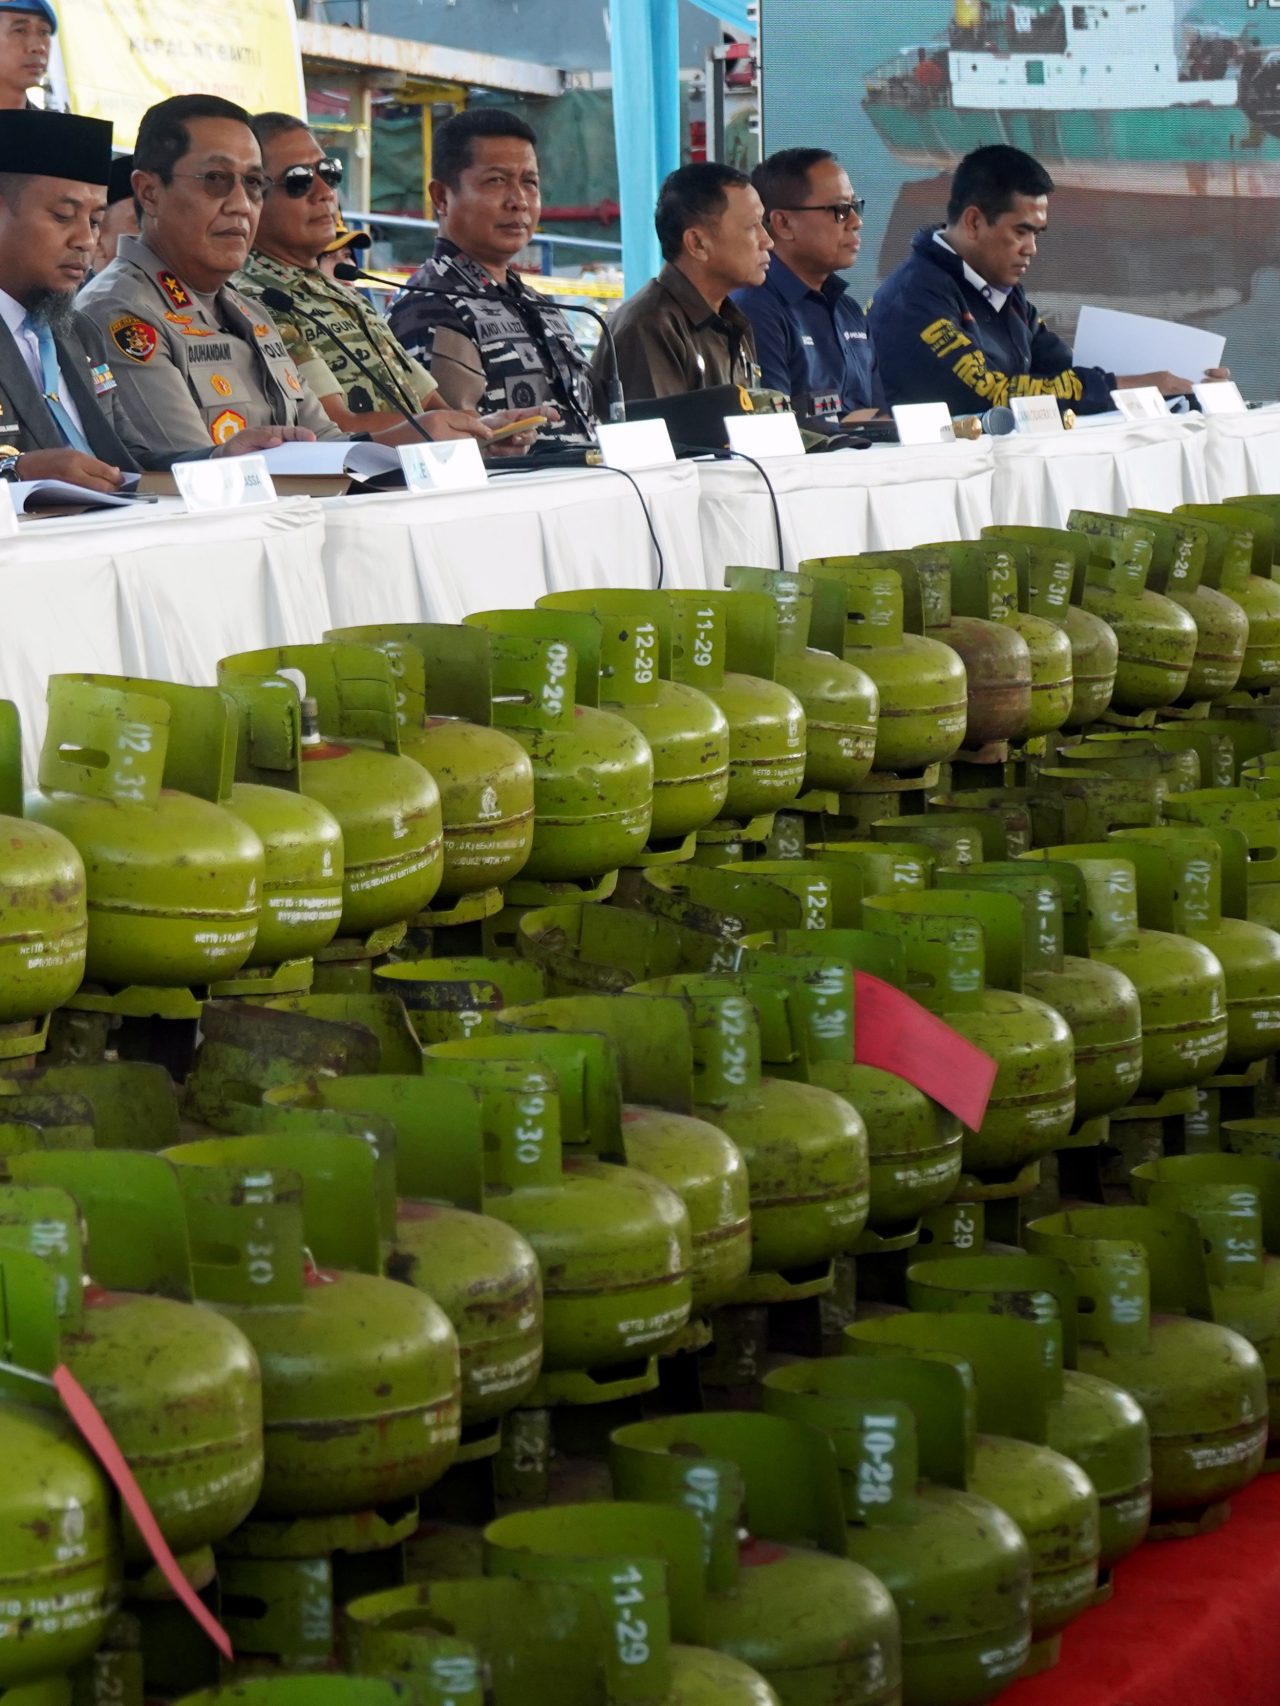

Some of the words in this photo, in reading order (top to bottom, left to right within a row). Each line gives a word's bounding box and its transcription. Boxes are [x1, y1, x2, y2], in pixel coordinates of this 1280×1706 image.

[634, 623, 655, 684] 12-29
[694, 607, 715, 667] 11-29
[953, 1202, 975, 1250] -29
[858, 1415, 898, 1504] 10-28
[612, 1565, 651, 1666] 11-29
